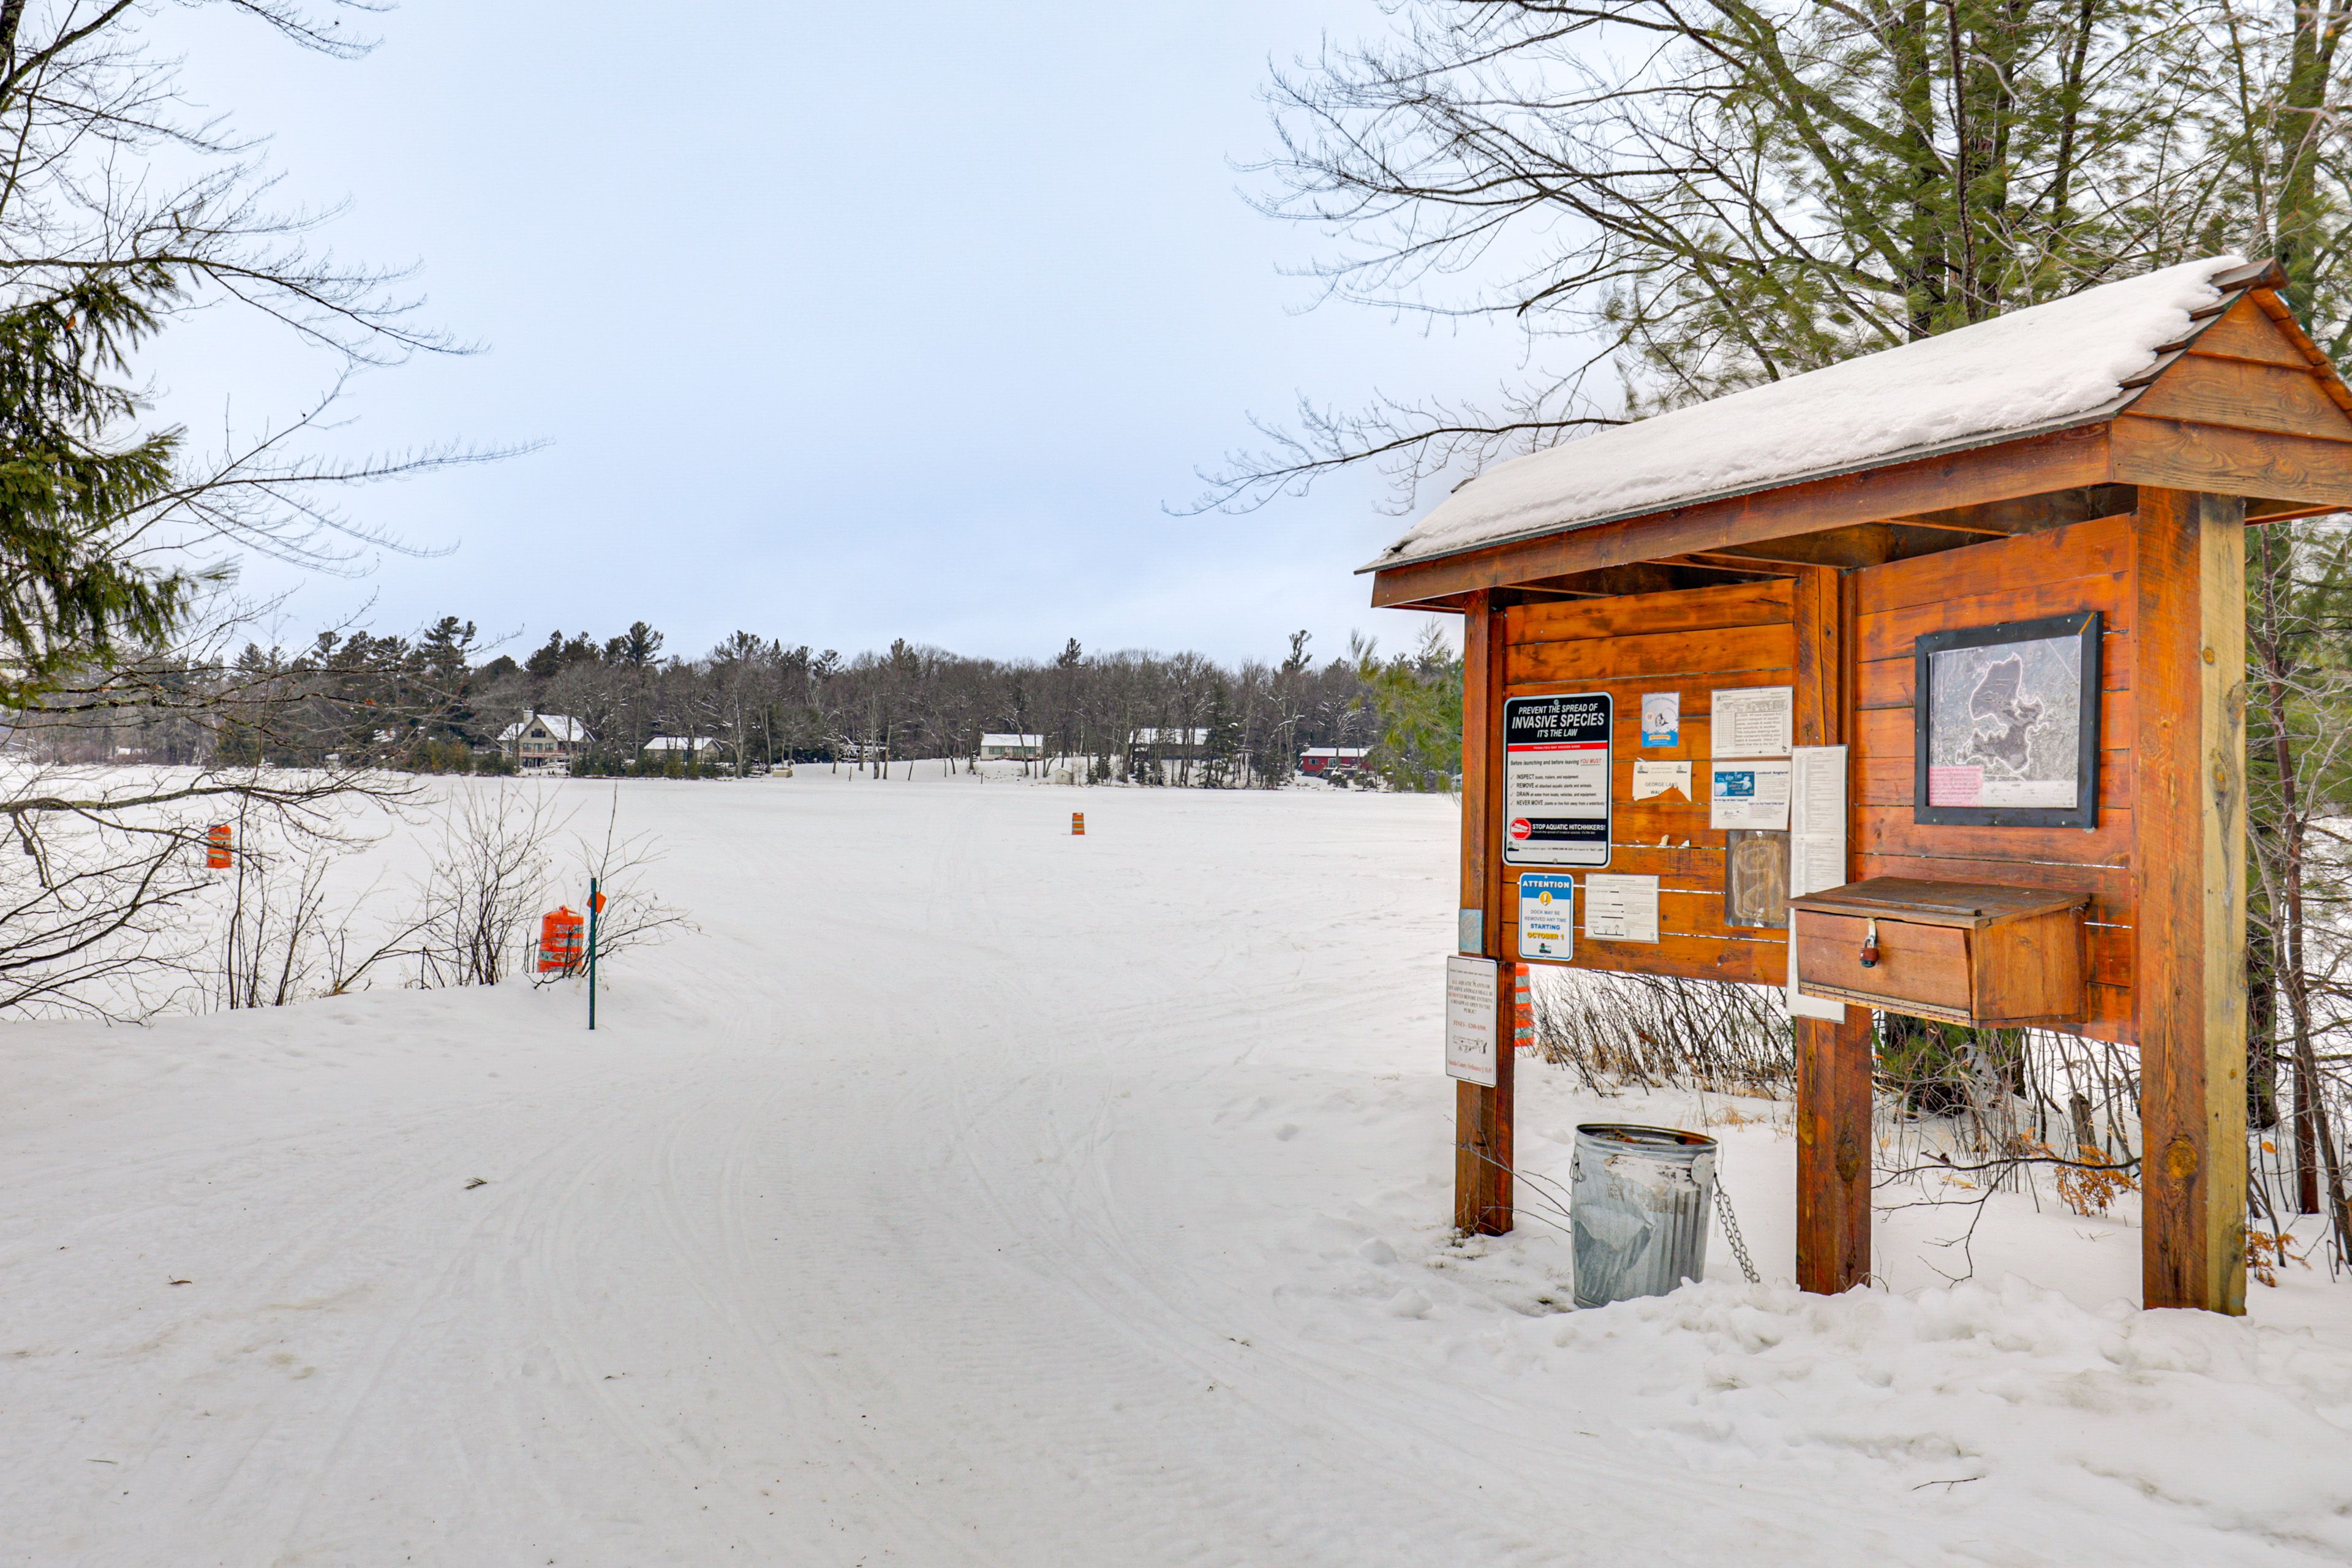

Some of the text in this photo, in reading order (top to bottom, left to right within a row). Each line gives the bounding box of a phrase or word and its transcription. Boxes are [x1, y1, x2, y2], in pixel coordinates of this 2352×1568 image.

[1519, 706, 1547, 714] PREVENT
[1512, 713, 1605, 729] INVASIVE SPECIES
[1563, 728, 1578, 737] LAW
